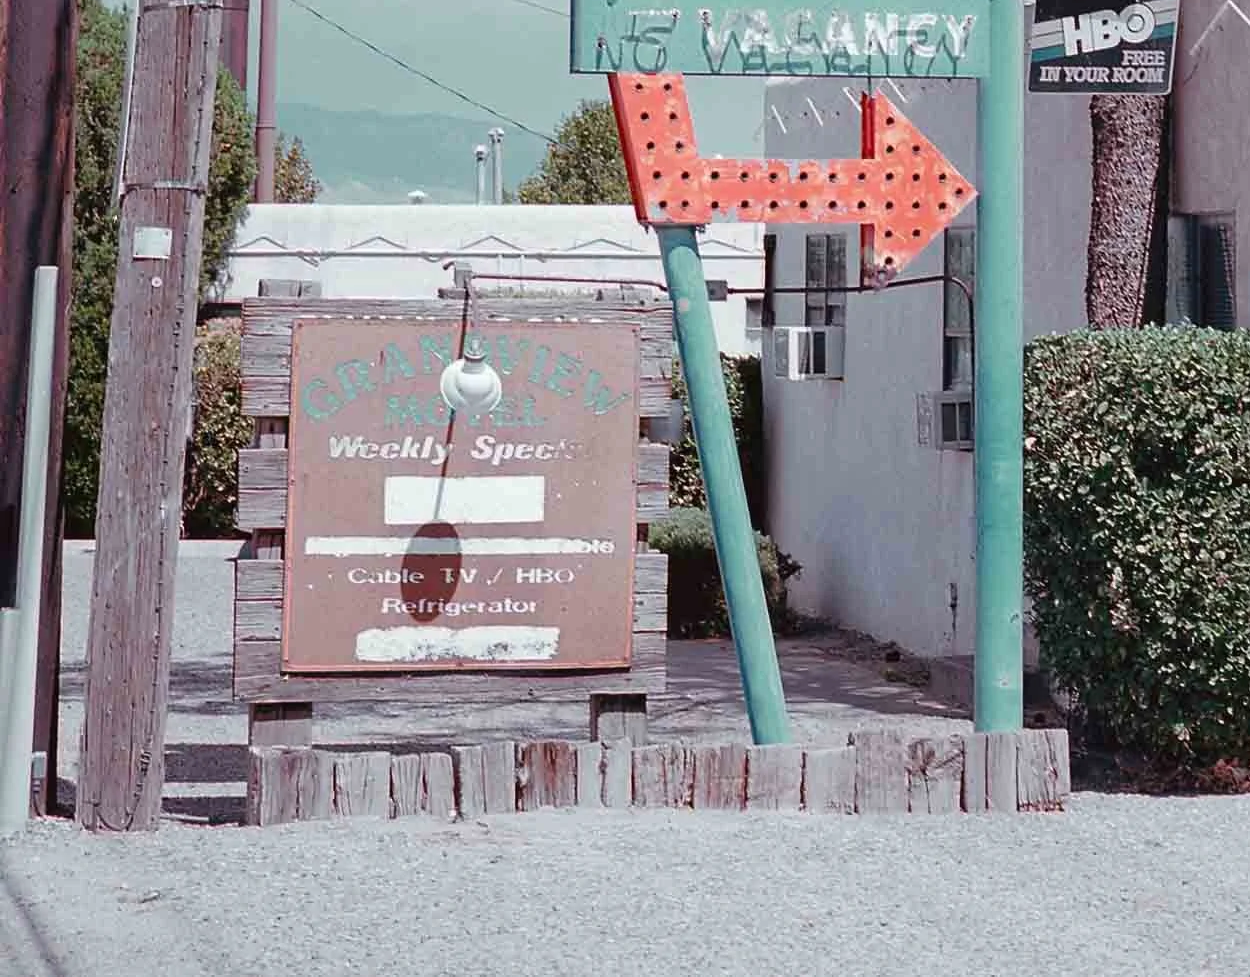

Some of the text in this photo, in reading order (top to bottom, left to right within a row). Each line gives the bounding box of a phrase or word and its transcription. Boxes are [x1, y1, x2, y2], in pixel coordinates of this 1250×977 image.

[696, 7, 979, 73] VACANCY
[1061, 1, 1156, 57] HBO
[1121, 49, 1166, 67] FREE
[1039, 65, 1165, 84] IN YOUR ROOM
[384, 394, 548, 426] MOEL
[328, 435, 455, 465] Weekly
[347, 567, 425, 585] Cable
[439, 568, 478, 584] TV
[515, 567, 577, 584] HBO
[380, 596, 538, 617] Refrigerator
